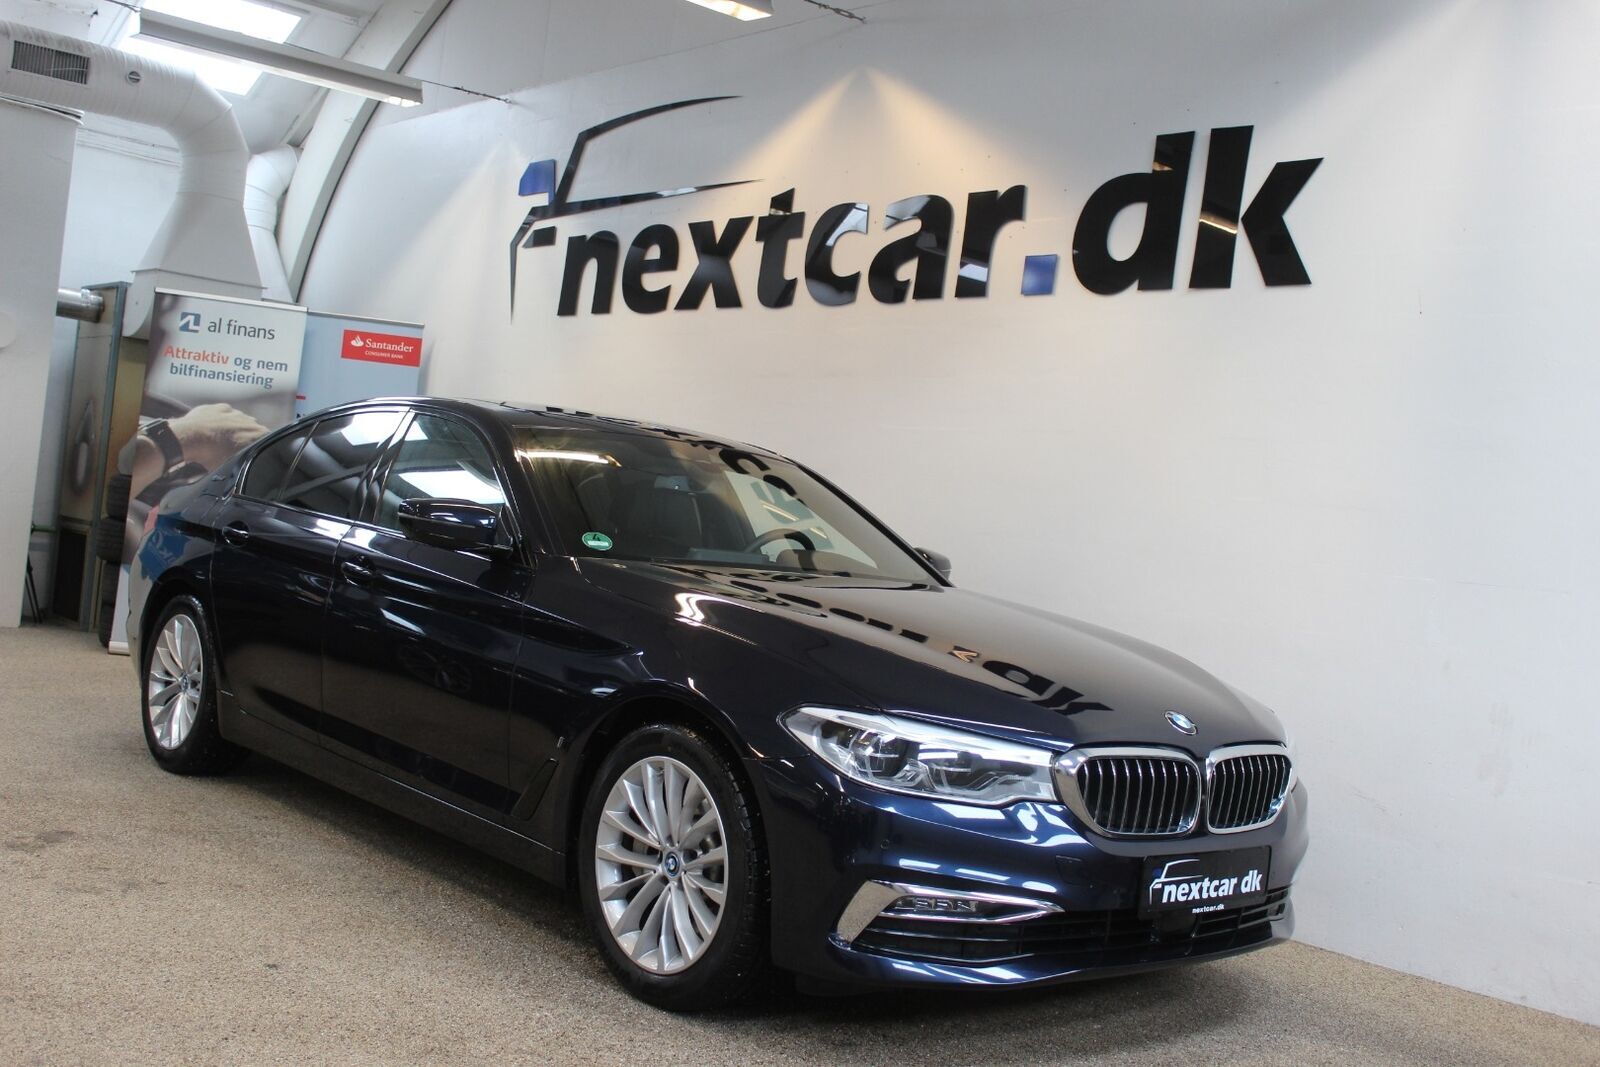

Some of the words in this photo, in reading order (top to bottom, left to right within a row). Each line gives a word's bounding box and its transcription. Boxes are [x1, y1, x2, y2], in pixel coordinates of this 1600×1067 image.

[557, 125, 1324, 316] nextcar.dk
[207, 318, 223, 333] al
[227, 319, 276, 340] finans
[365, 350, 391, 358] CONSUMER
[391, 352, 404, 360] BANK
[366, 338, 414, 353] Santander
[163, 345, 230, 365] Attraktiv
[234, 357, 252, 371] og
[256, 359, 289, 372] nem
[170, 362, 274, 390] bilfinansiering
[1191, 903, 1225, 914] nextcar.dk
